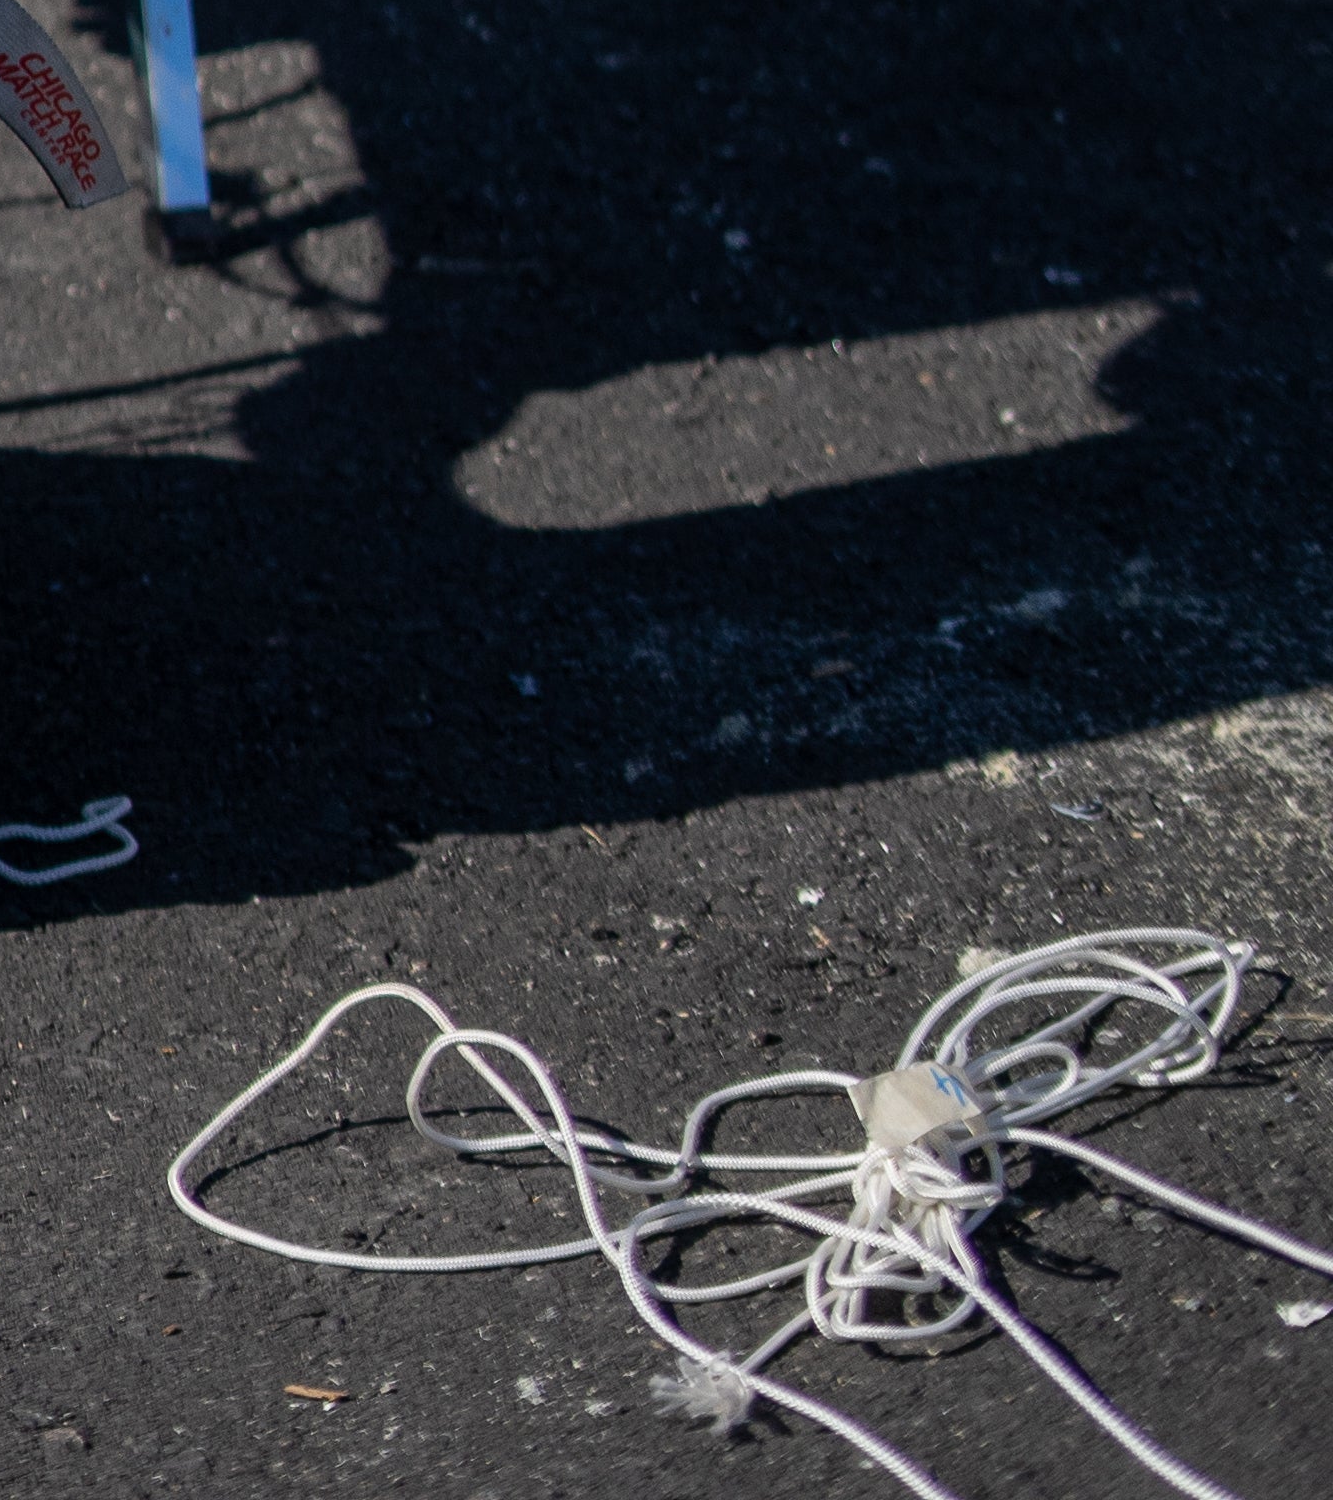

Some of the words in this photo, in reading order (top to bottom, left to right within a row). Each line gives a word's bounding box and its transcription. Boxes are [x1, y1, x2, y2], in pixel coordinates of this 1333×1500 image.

[19, 52, 101, 162] CHICAGO
[20, 108, 67, 166] CENTER
[55, 132, 97, 193] RACE
